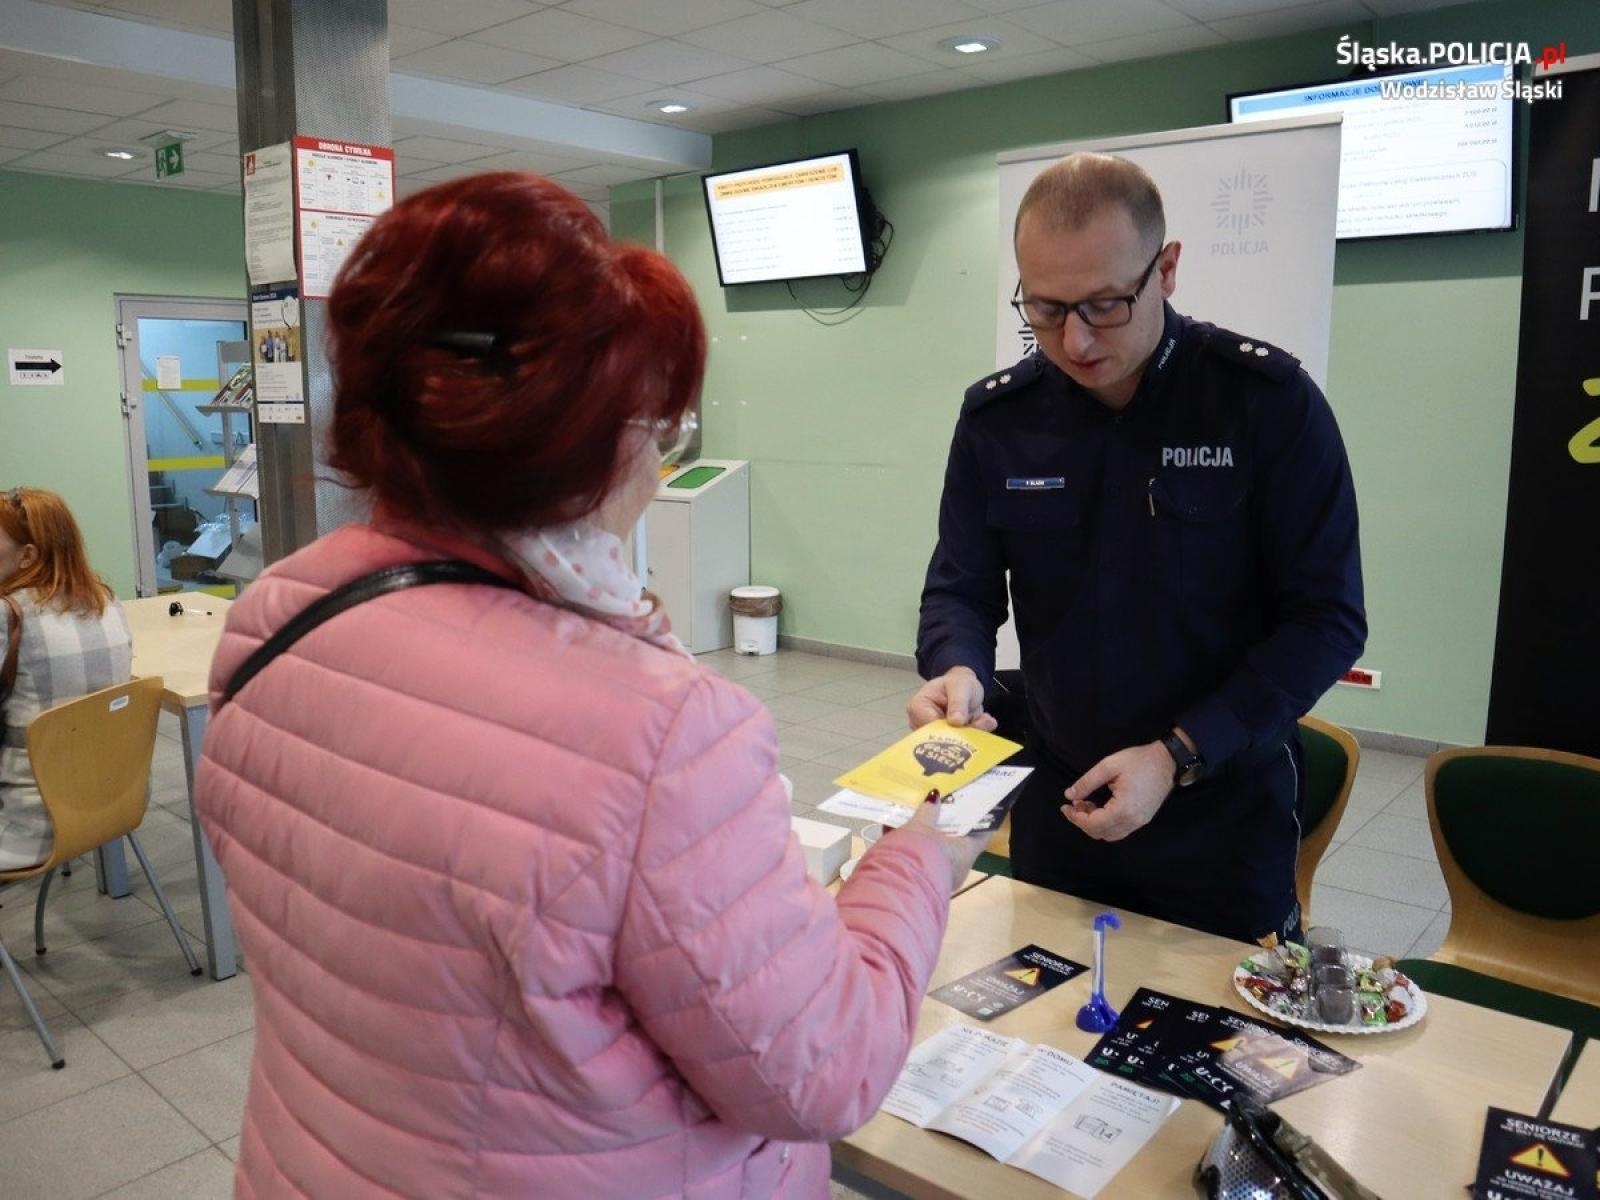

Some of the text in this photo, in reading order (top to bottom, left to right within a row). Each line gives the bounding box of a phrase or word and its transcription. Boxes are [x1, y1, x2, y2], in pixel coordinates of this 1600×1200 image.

[1304, 87, 1361, 103] INFORMACJE
[1211, 242, 1268, 258] POLICJA
[1157, 337, 1177, 370] POLICJA
[1161, 446, 1234, 469] POLICJA
[1505, 1118, 1582, 1143] SENIORZE
